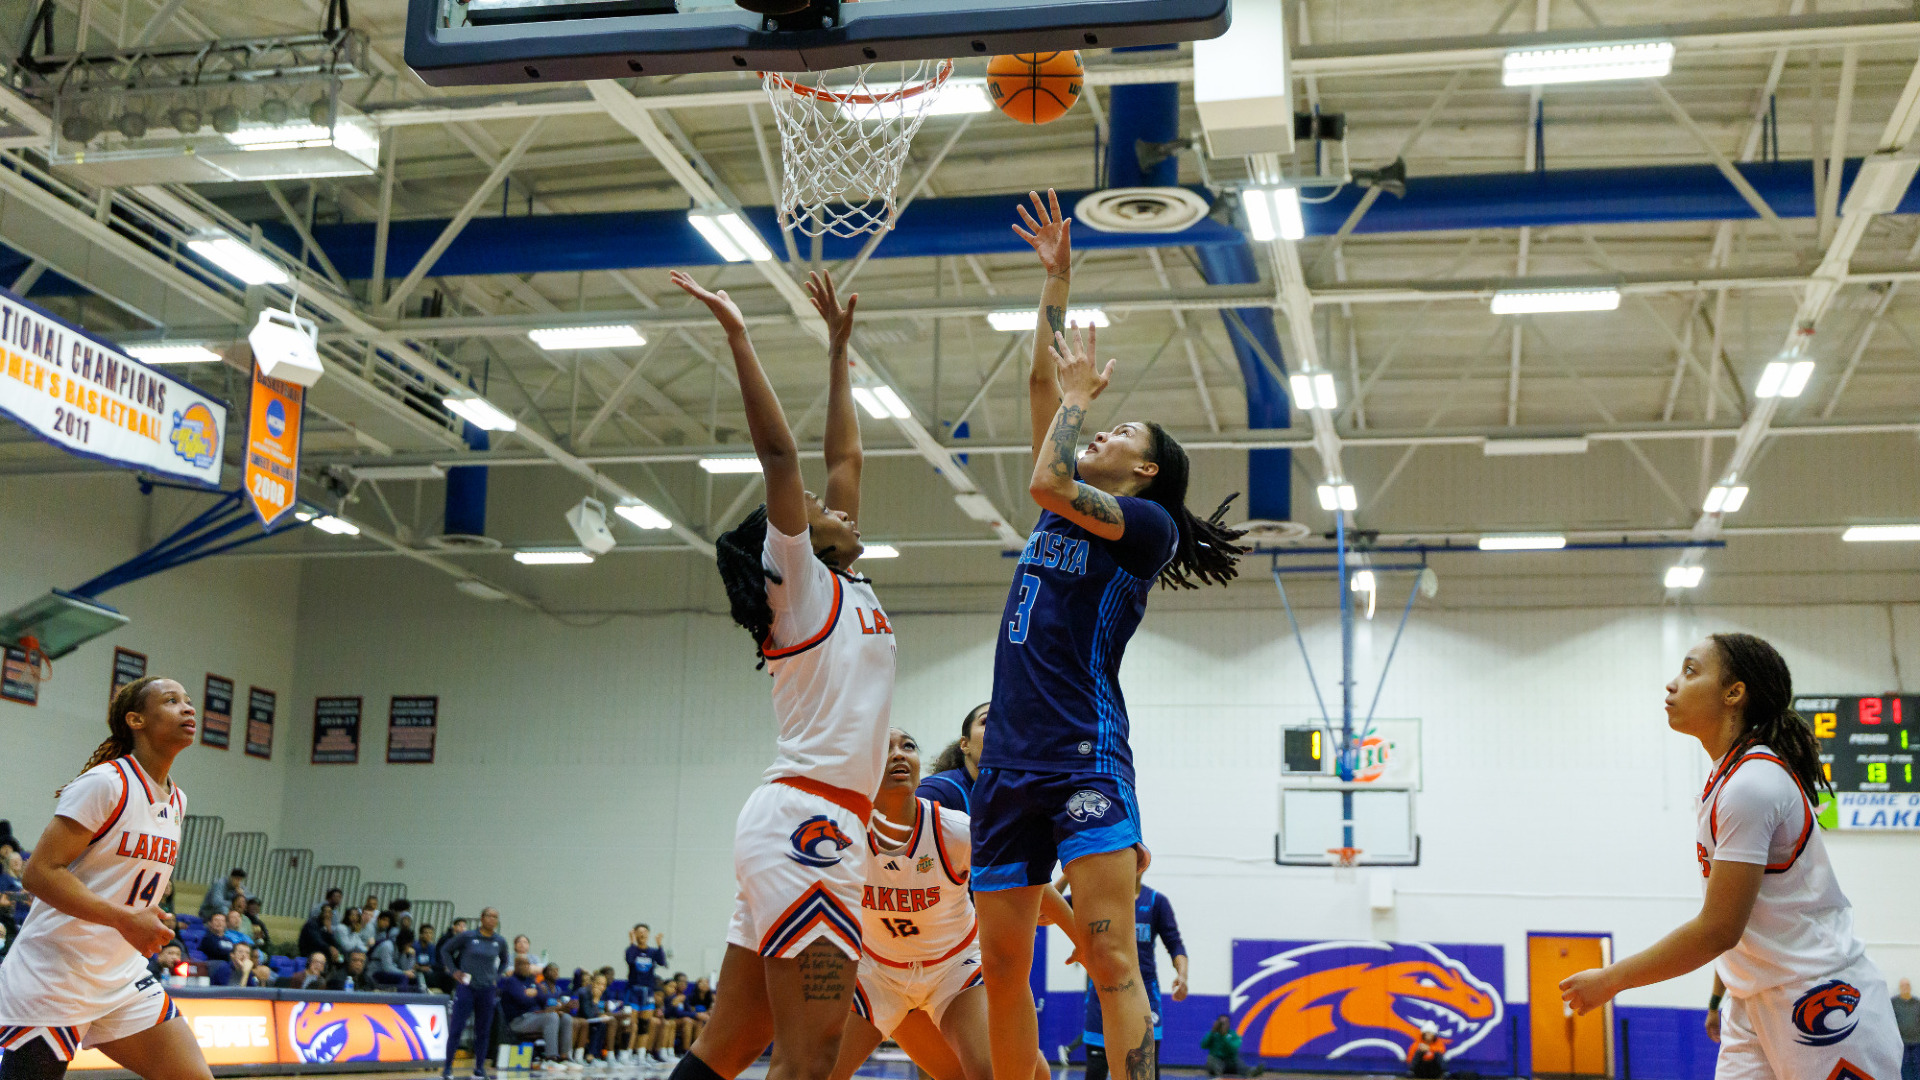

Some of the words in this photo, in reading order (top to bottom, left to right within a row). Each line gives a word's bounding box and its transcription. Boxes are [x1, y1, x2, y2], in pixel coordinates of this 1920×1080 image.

[71, 341, 167, 415] CHAMPIONS
[53, 406, 91, 444] 2011
[65, 379, 162, 444] BASKETBALL
[254, 472, 286, 508] 2008
[1008, 572, 1042, 645] 3
[1311, 730, 1321, 760] 1
[1842, 793, 1899, 806] HOME
[124, 868, 161, 908] 14
[879, 917, 921, 939] 12
